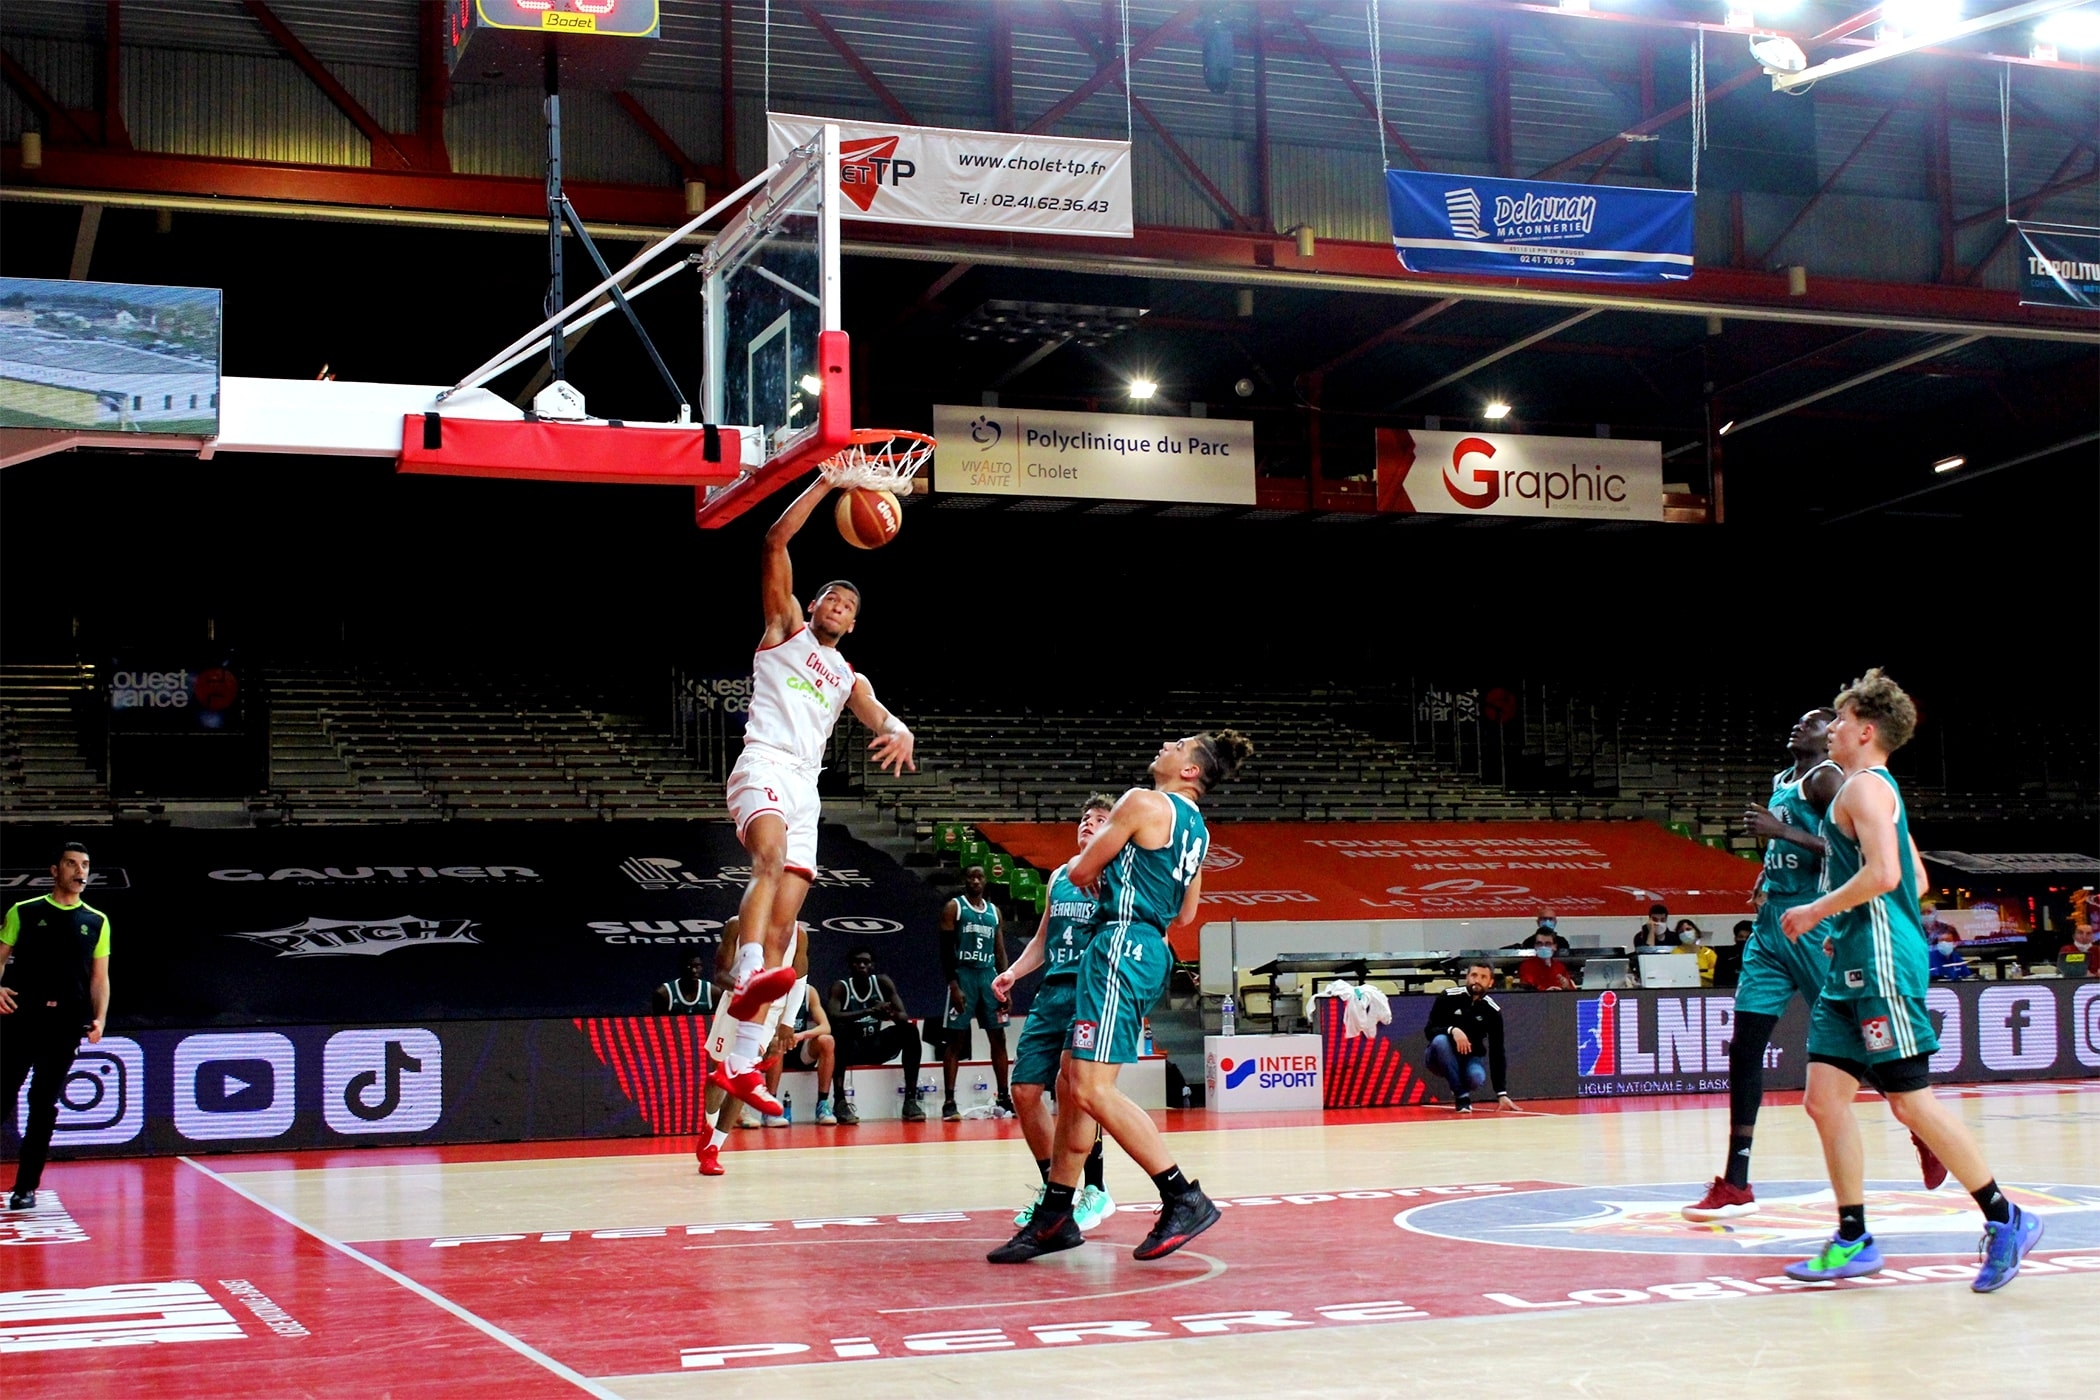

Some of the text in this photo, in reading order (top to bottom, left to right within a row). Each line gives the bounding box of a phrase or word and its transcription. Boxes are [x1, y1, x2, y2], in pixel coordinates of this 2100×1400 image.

[546, 14, 593, 28] Bodet
[958, 154, 1106, 177] www.cholet-tp.fr
[958, 192, 980, 205] Tel
[991, 194, 1109, 214] 02.41.62.36.43
[1494, 192, 1596, 234] Delaunay
[1497, 223, 1582, 237] MAÇONNERIE
[1520, 255, 1530, 263] 02
[1531, 256, 1541, 264] 41
[1554, 257, 1564, 265] 00
[1565, 258, 1575, 266] 95
[1027, 429, 1230, 456] Polyclinique du Parc
[961, 459, 1012, 474] VIVALTO
[1027, 463, 1078, 480] Cholet
[1443, 437, 1626, 509] Graphic
[877, 500, 897, 533] Jeep
[113, 669, 189, 689] ouest
[111, 688, 189, 708] rance
[1305, 839, 1408, 848] TOUS
[1340, 849, 1470, 858] NOTRE
[208, 866, 540, 881] GAUTIER
[976, 937, 984, 950] 5
[1063, 925, 1074, 946] 4
[1123, 939, 1143, 961] 14
[1260, 1056, 1317, 1072] INTER
[1259, 1072, 1317, 1089] SPORT
[1578, 1082, 1613, 1095] LIGUE
[1616, 1080, 1683, 1093] NATIONALE
[1699, 1079, 1730, 1090] BASK
